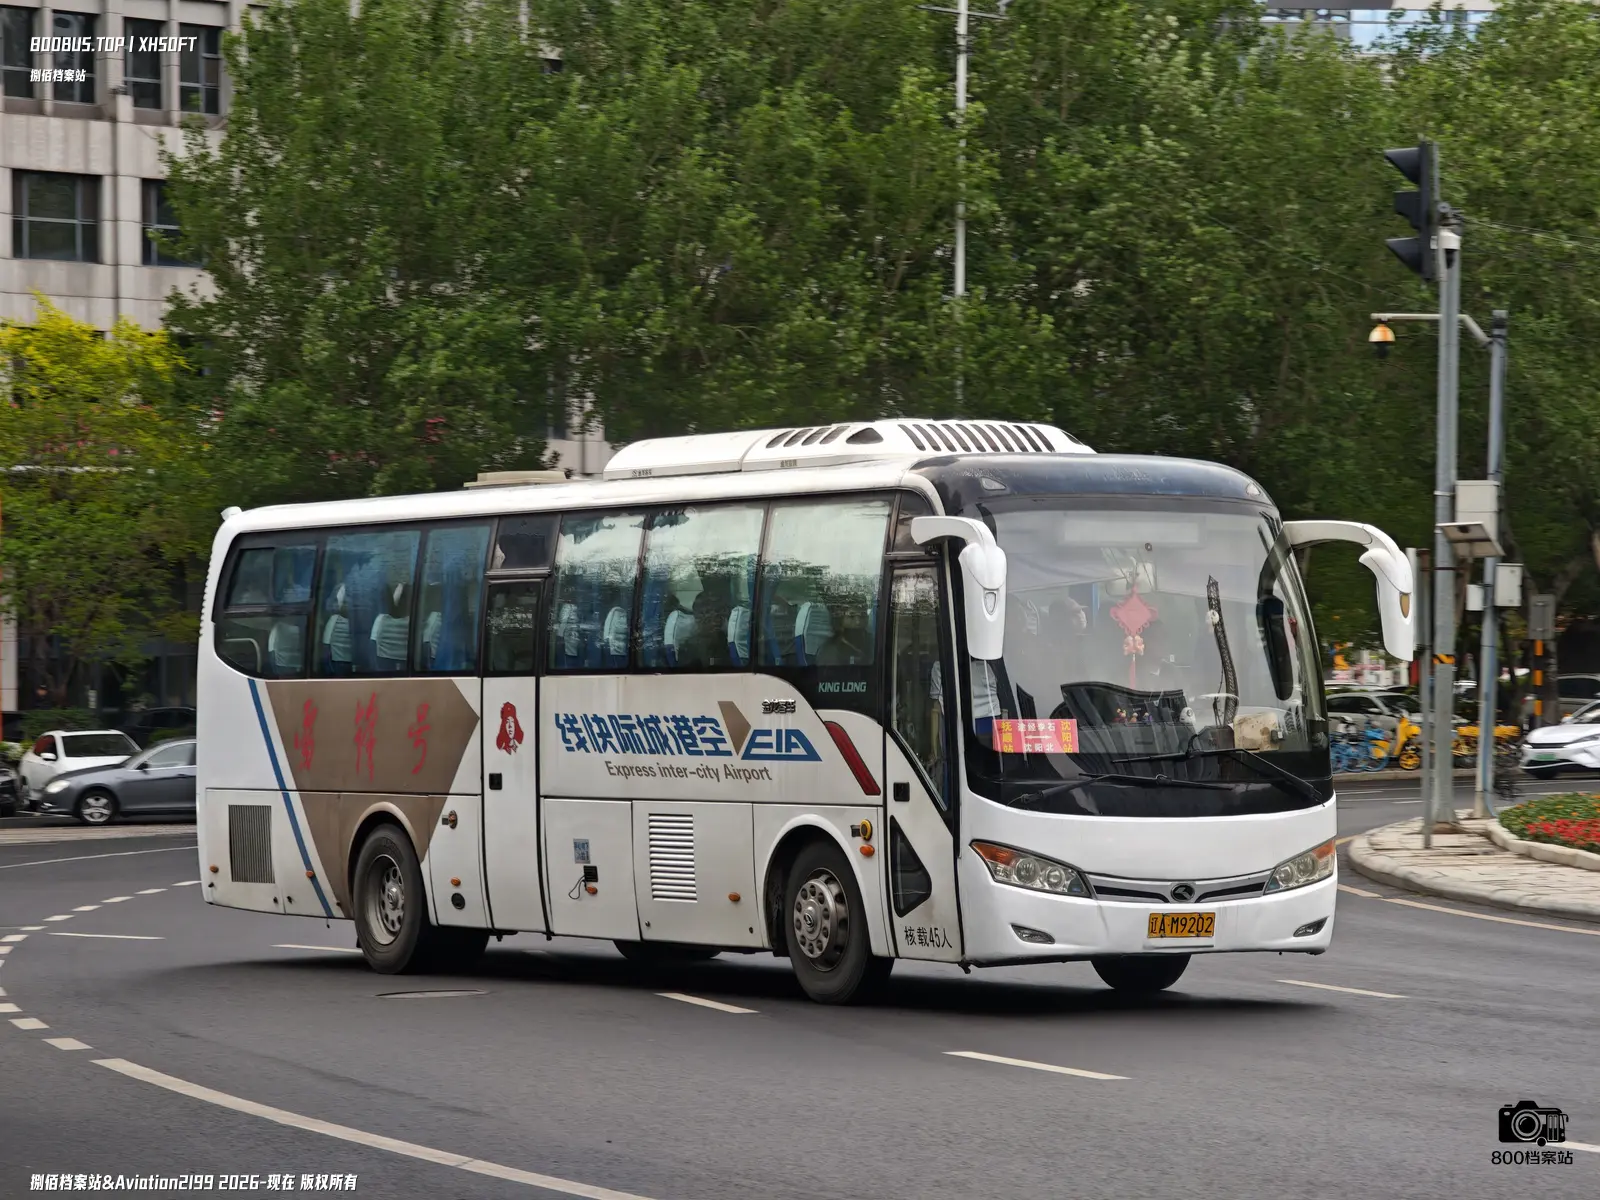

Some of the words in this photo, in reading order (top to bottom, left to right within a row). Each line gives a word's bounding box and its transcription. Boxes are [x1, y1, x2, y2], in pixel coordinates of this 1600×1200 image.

[818, 682, 840, 693] KING
[842, 682, 867, 692] LONG
[1024, 742, 1054, 752] 沈阳北
[604, 760, 657, 780] Express
[657, 762, 721, 783] inter-city
[724, 763, 773, 784] Airport
[904, 925, 953, 949] 核载45人
